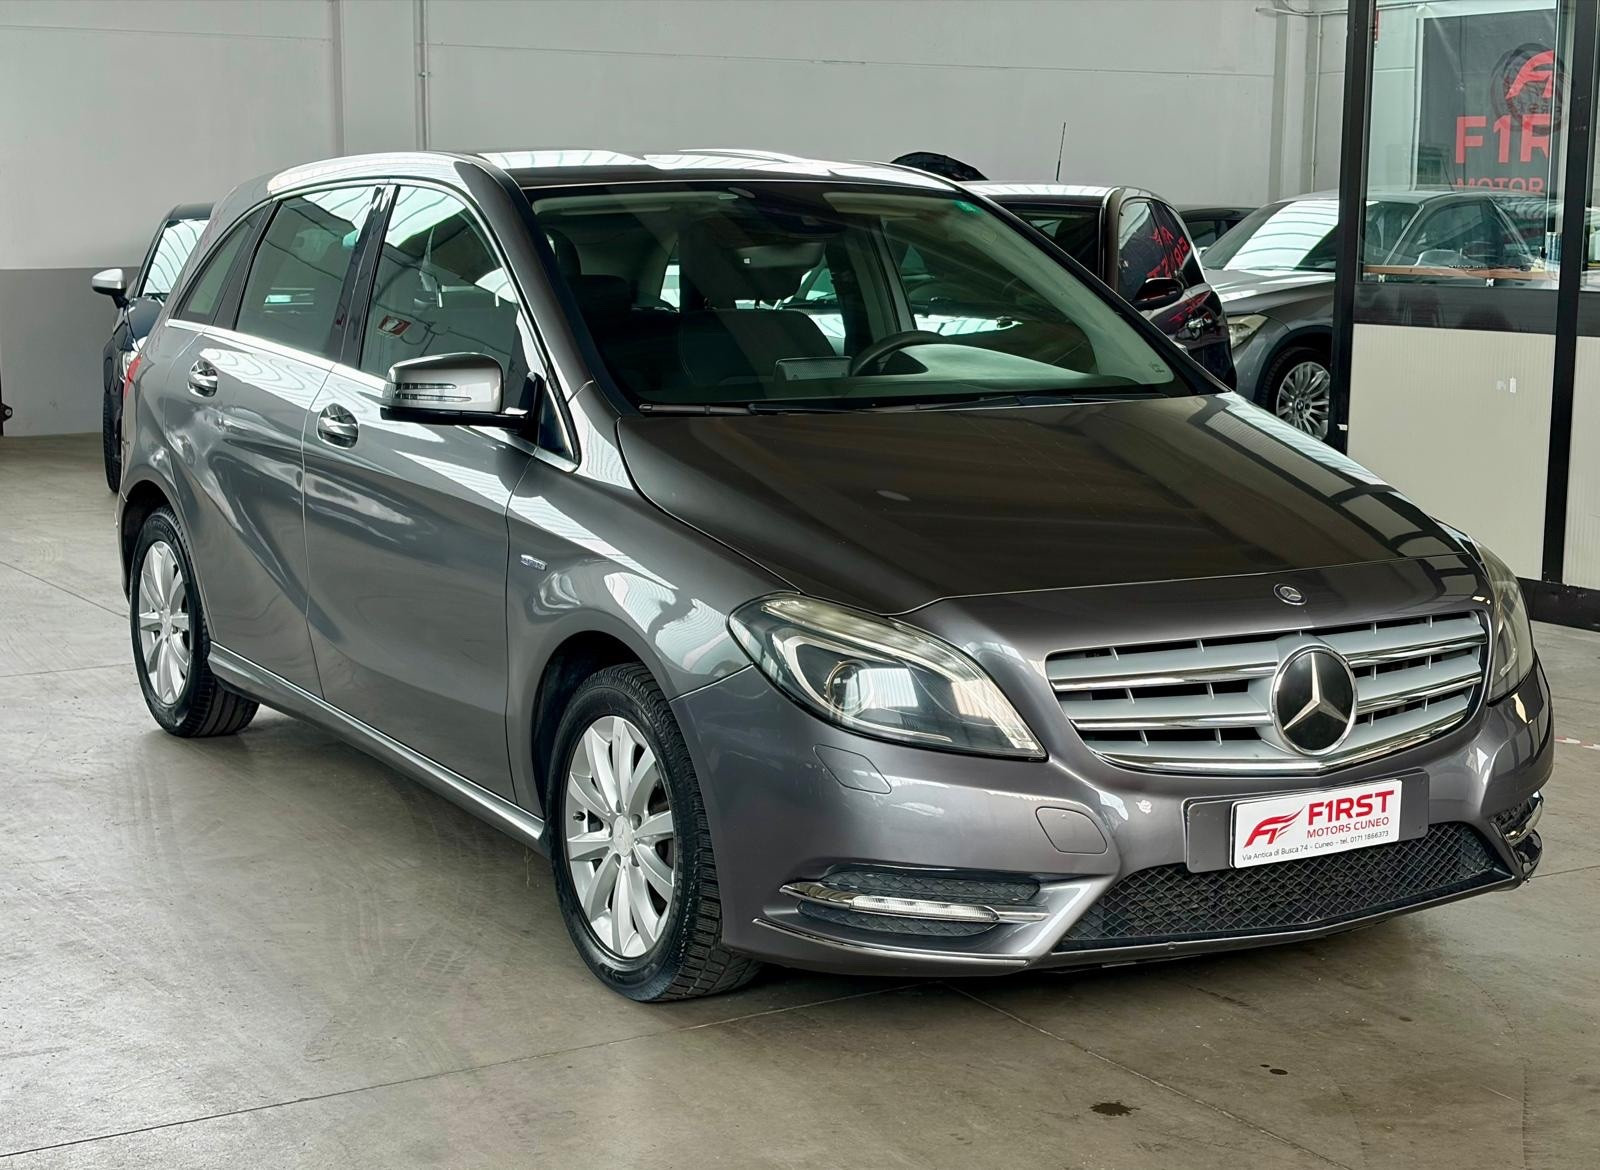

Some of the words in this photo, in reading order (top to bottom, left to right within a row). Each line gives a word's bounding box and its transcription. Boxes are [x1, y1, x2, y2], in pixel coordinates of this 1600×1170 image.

[1308, 789, 1395, 826] F1RST
[1307, 823, 1351, 838] MOTORS
[1354, 816, 1390, 831] CUNEO
[1253, 850, 1273, 859] Antica
[1273, 848, 1280, 856] di
[1281, 846, 1299, 855] Busca
[1300, 844, 1308, 852] 74
[1314, 841, 1334, 849] Cuneo
[1340, 837, 1349, 845] tel.
[1350, 834, 1363, 843] 0171
